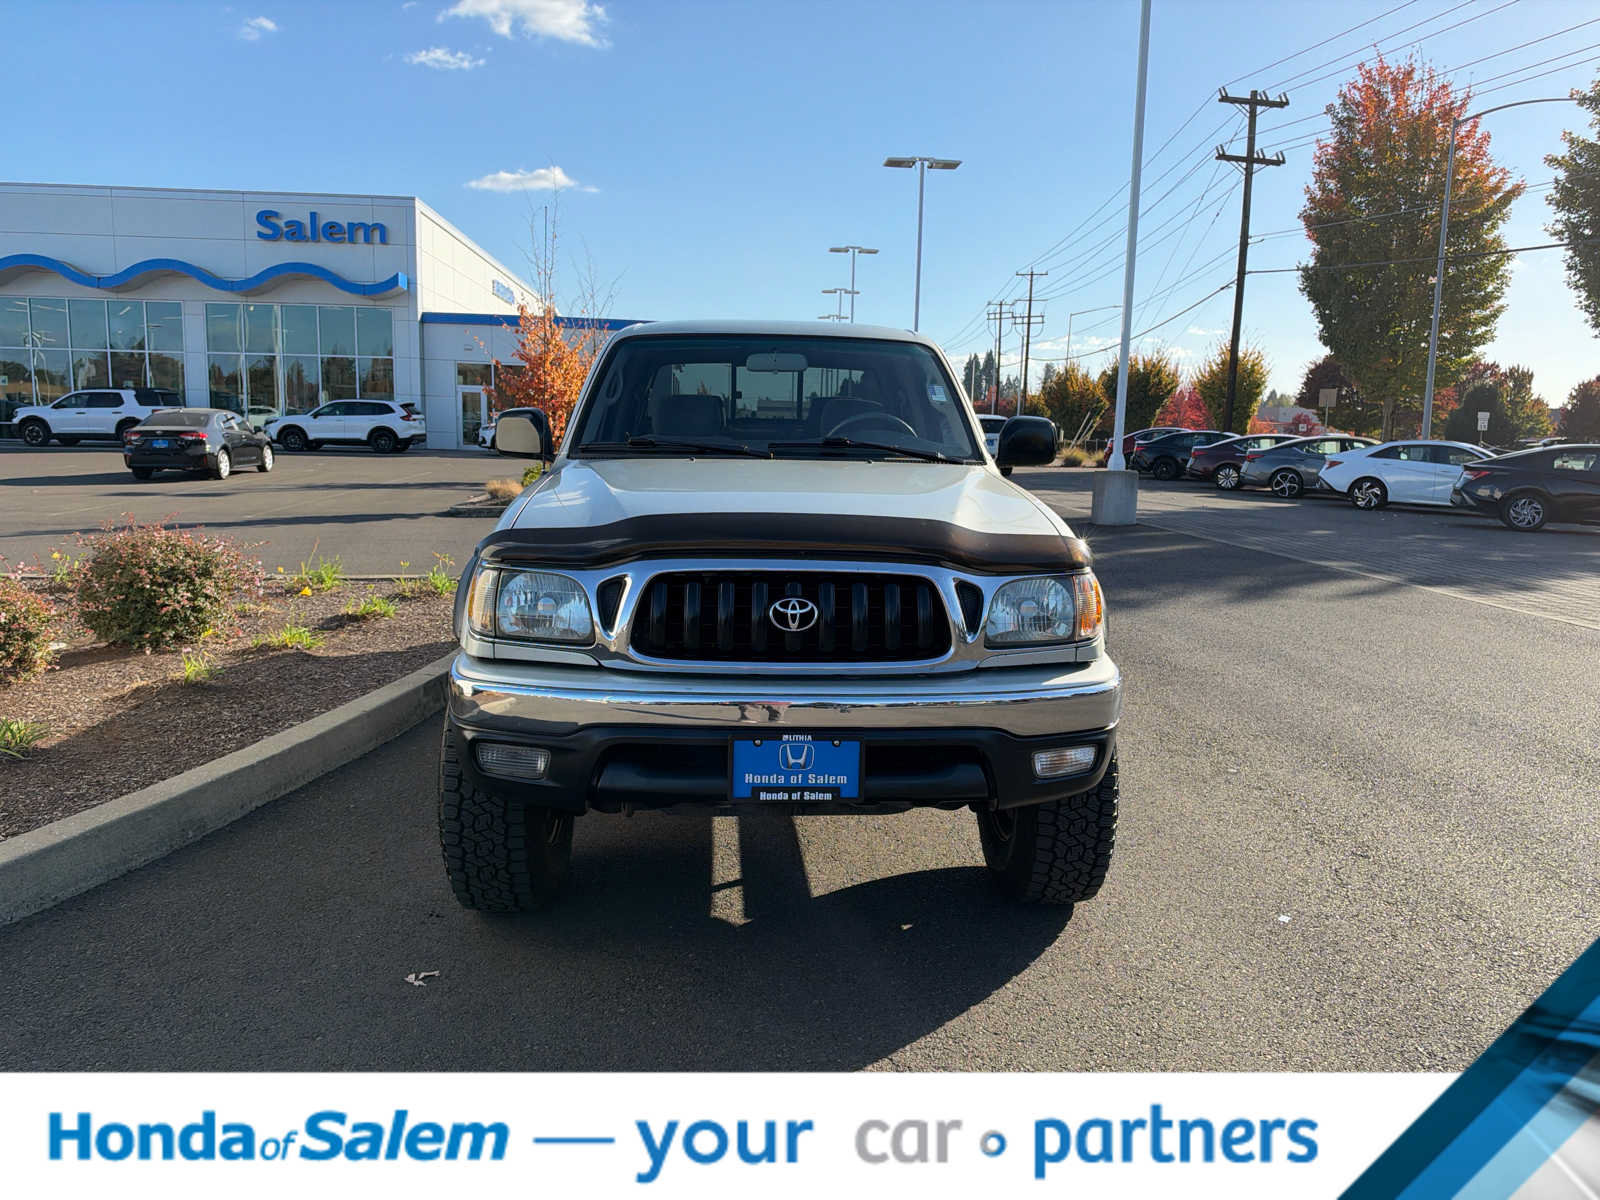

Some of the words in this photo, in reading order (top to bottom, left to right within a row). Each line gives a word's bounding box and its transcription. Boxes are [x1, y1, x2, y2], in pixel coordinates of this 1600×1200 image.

[256, 210, 388, 244] Salem
[789, 734, 812, 742] LITHIA
[744, 773, 785, 784] Honda
[790, 773, 803, 784] of
[808, 773, 848, 784] Salem
[760, 791, 789, 801] Honda
[791, 791, 801, 801] of
[803, 791, 833, 801] Salem
